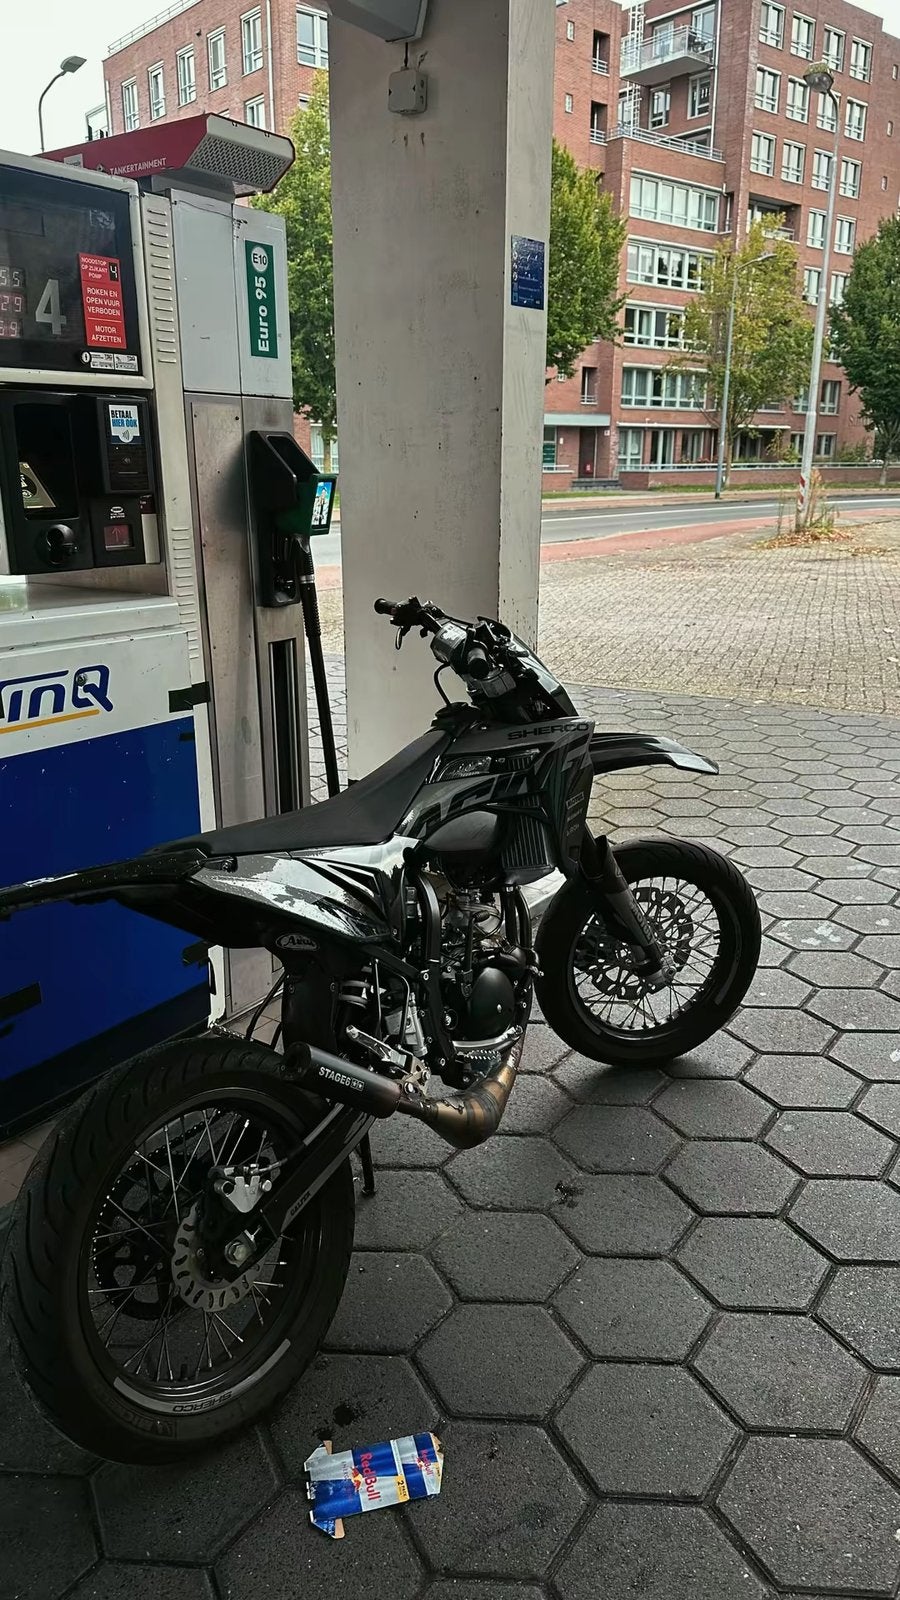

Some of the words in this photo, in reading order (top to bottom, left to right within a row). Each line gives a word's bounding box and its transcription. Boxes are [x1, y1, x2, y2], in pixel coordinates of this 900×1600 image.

[110, 158, 167, 175] TANKERTAINMENT
[81, 257, 107, 266] NOODSTOP
[253, 253, 267, 266] E10
[110, 265, 118, 279] 4
[87, 287, 109, 297] ROKEN
[109, 290, 118, 298] EN
[254, 275, 268, 300] 95
[35, 278, 67, 335] 4
[86, 296, 103, 305] OPEN
[103, 299, 120, 307] VUUR
[87, 306, 121, 316] VERBODEN
[95, 325, 117, 334] MOTOR
[258, 305, 270, 352] Euro
[91, 334, 122, 343] AFZETTEN
[111, 410, 133, 418] BETAAL
[112, 419, 125, 427] HIER
[126, 419, 138, 427] OOK
[508, 723, 589, 740] SHERCO
[318, 1066, 350, 1086] STAGE6
[172, 1390, 233, 1412] SHERCO
